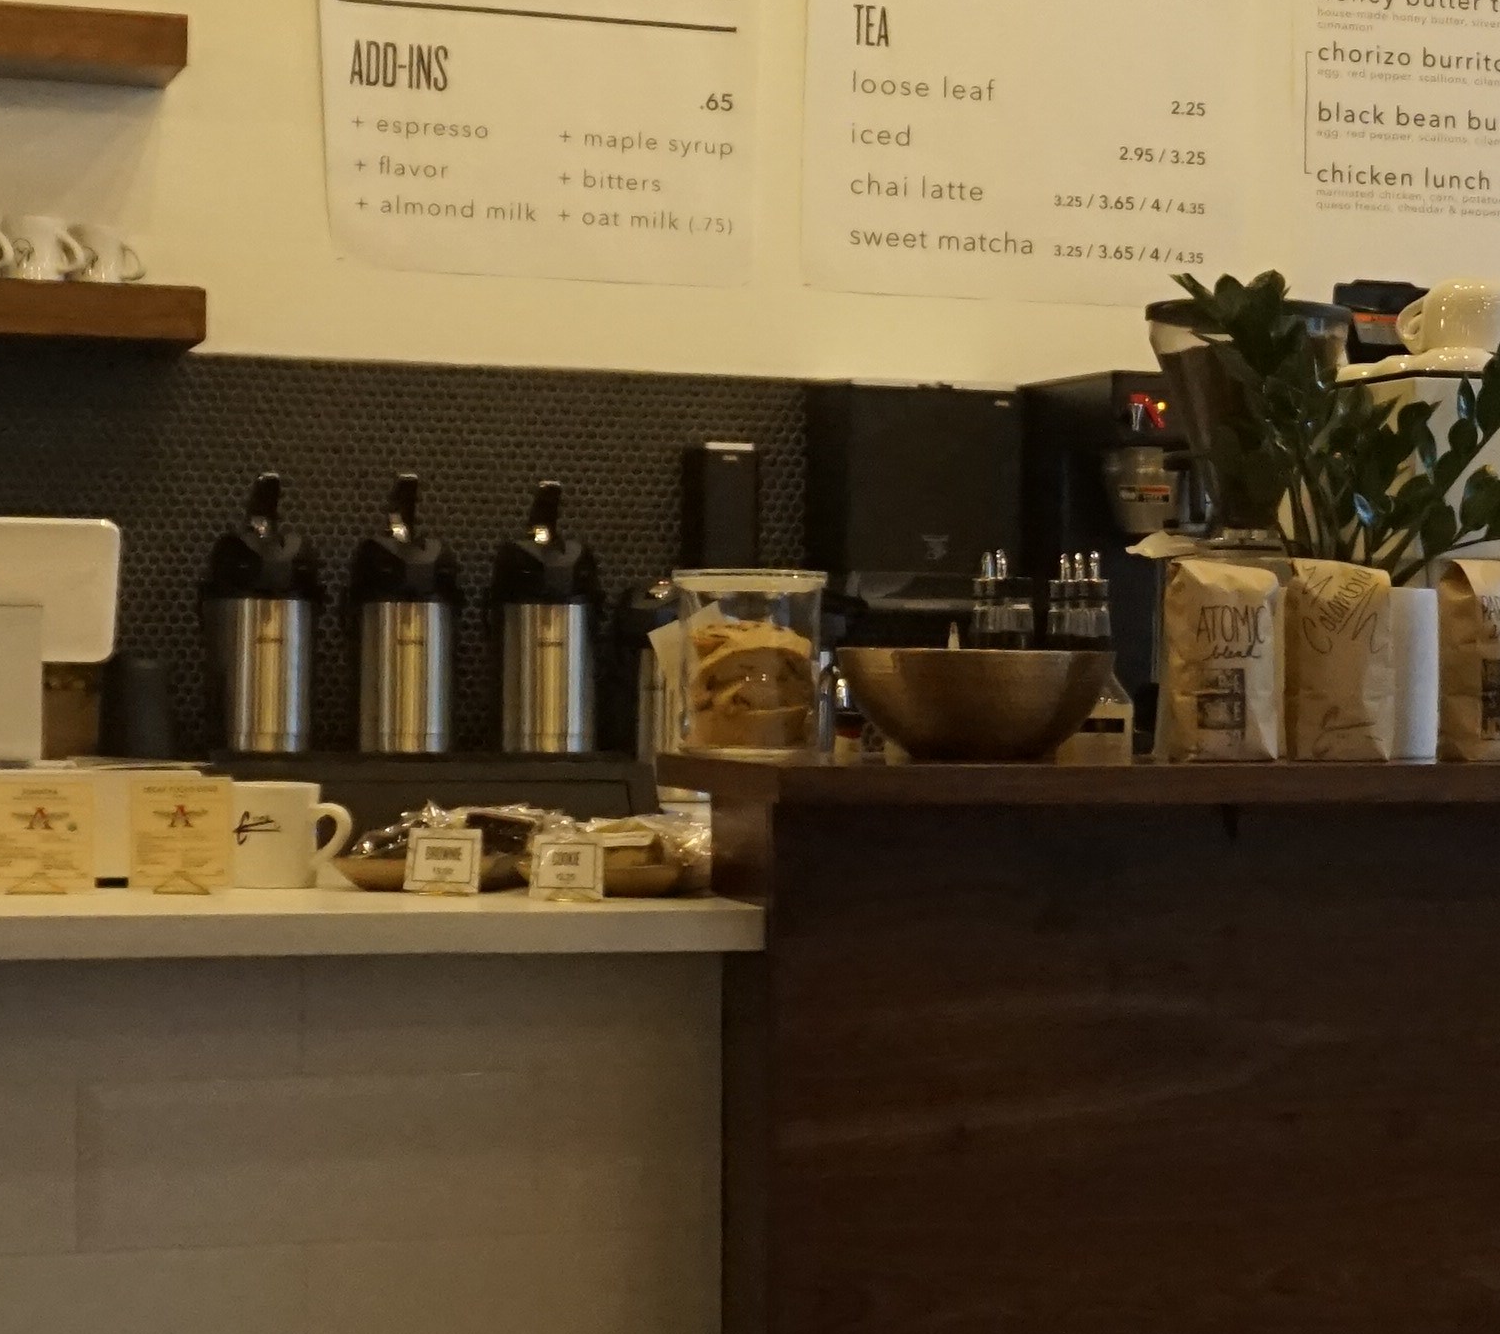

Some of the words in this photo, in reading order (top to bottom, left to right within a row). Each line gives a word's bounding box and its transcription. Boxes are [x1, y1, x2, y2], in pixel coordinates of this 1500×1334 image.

[853, 3, 890, 48] TEA
[349, 39, 449, 93] ADD-INS
[1317, 40, 1412, 67] chorizo
[852, 69, 930, 98] loose
[943, 75, 996, 102] leaf
[699, 92, 734, 113] .65
[1170, 100, 1207, 117] 2.25
[1317, 100, 1385, 125] black
[1395, 105, 1457, 129] bean
[375, 118, 489, 140] espresso
[851, 124, 911, 147] iced
[583, 131, 658, 154] maple
[668, 138, 734, 160] syrup
[1118, 145, 1155, 163] 2.95
[1170, 149, 1207, 166] 3.25
[378, 154, 449, 179] flavor
[1316, 162, 1413, 187] chicken
[1424, 166, 1491, 191] lunch
[582, 168, 662, 193] bitters
[849, 172, 908, 197] chai
[921, 175, 984, 202] latte
[379, 194, 475, 219] almond
[486, 202, 537, 223] milk
[1054, 194, 1083, 208] 3.25
[1098, 194, 1135, 211] 3.65
[1150, 198, 1162, 212] 4
[581, 211, 620, 227] oat
[630, 210, 679, 231] milk
[849, 229, 928, 250] sweet
[937, 230, 1034, 256] matcha
[1053, 244, 1083, 258] 3.25
[1098, 244, 1135, 261] 3.65
[1149, 247, 1160, 262] 4
[1196, 605, 1267, 644] ATOMIC
